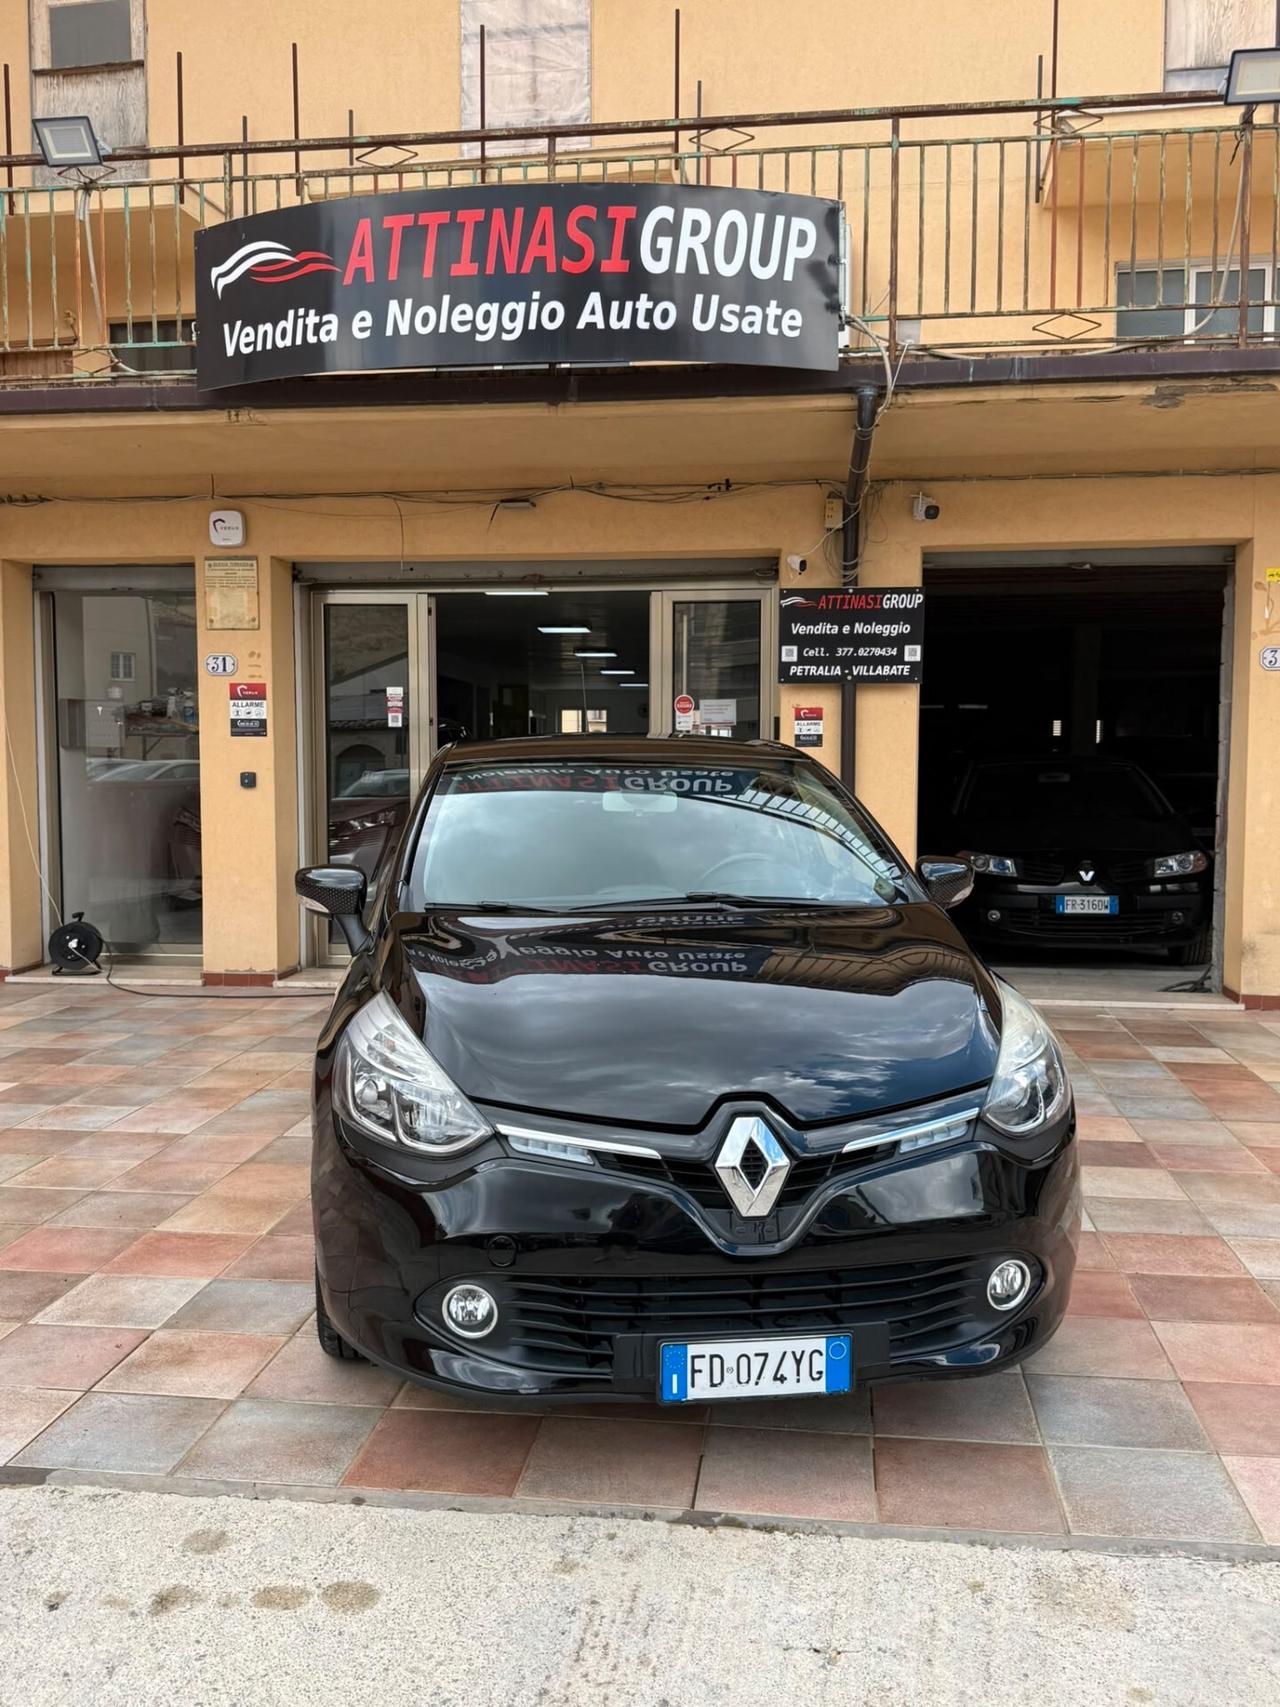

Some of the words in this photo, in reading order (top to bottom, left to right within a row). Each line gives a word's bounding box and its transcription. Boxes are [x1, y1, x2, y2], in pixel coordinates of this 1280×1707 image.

[222, 308, 339, 357] Vendita
[351, 312, 372, 339] e
[385, 290, 566, 342] Noleggio
[576, 292, 677, 331] Auto
[691, 294, 804, 338] Usate
[791, 623, 839, 635] Vendita
[842, 625, 850, 634] e
[854, 622, 911, 636] Noleggio
[803, 647, 830, 657] Cell.
[211, 657, 227, 673] 31
[790, 665, 842, 676] PETRALIA
[852, 665, 911, 676] VILLABATE
